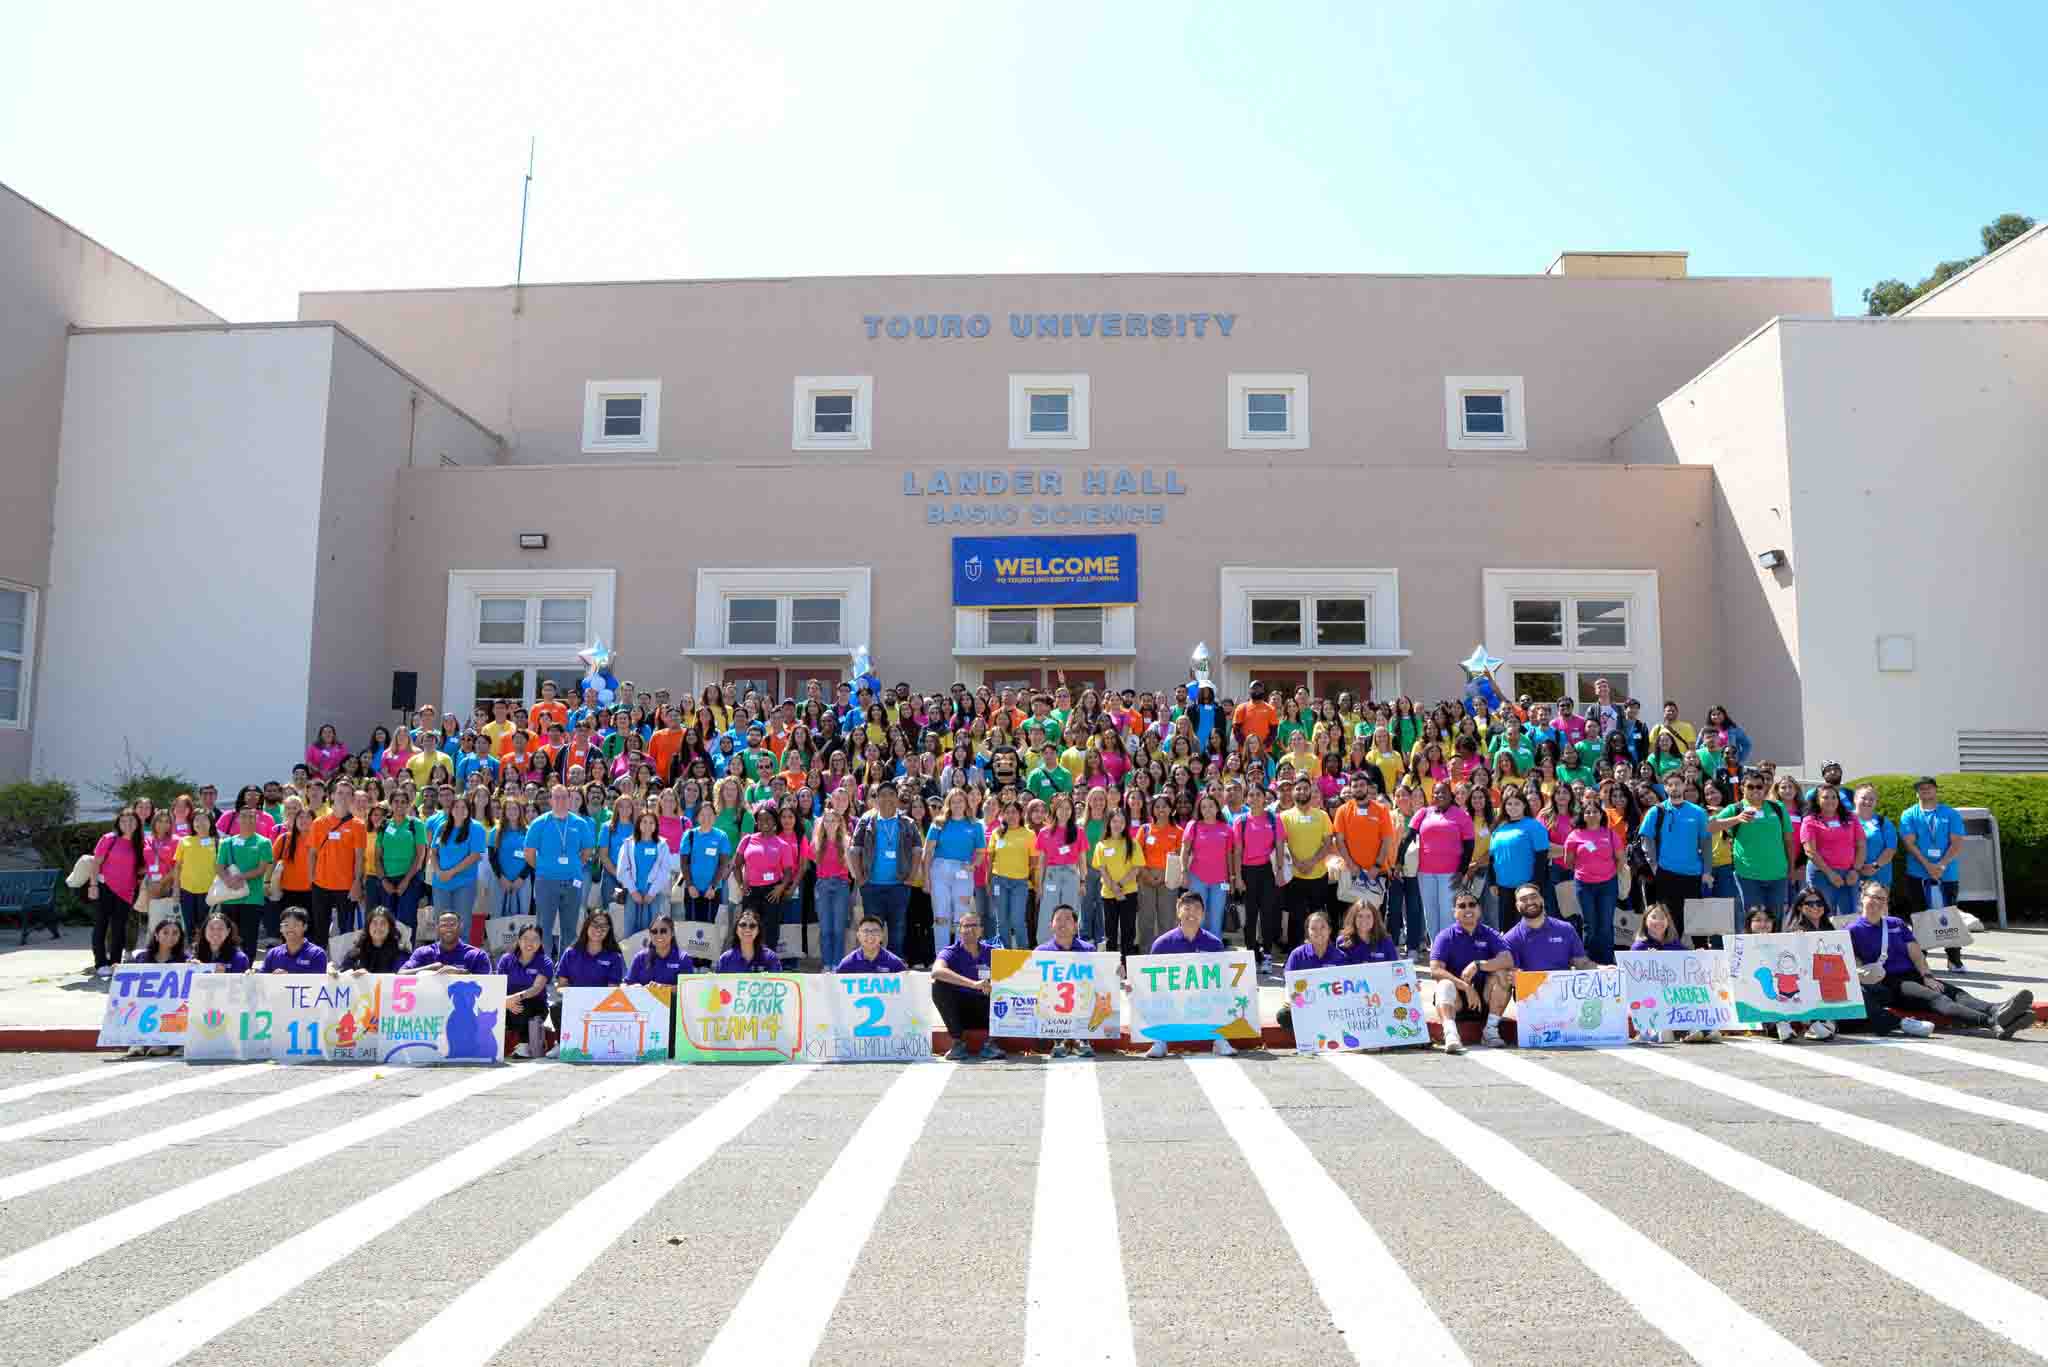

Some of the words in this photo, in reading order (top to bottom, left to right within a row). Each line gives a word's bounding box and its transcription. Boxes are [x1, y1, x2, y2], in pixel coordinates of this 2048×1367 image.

[863, 314, 992, 339] TOURO
[1008, 313, 1237, 338] UNIVERSITY
[903, 469, 1063, 496] LANDER
[1081, 469, 1186, 495] HALL
[926, 505, 1018, 527] BASIC
[1031, 503, 1168, 526] SCIENCE
[994, 556, 1120, 576] WELCOME
[1036, 960, 1095, 982] TEAM
[1141, 964, 1221, 992] TEAM
[1229, 963, 1248, 988] 7
[284, 985, 352, 1009] TEAM
[391, 977, 417, 1014] 5
[737, 980, 788, 998] FOOD
[840, 978, 900, 994] TEAM
[1055, 982, 1074, 1014] 3
[1318, 979, 1370, 996] TEAM
[1551, 972, 1621, 1000] TEAM
[138, 1004, 159, 1033] 6
[733, 998, 784, 1015] BANK
[853, 997, 892, 1037] 2
[239, 1009, 273, 1041] 12
[286, 1020, 322, 1056] 11
[592, 1024, 632, 1040] TEAM
[696, 1015, 759, 1041] TEAM
